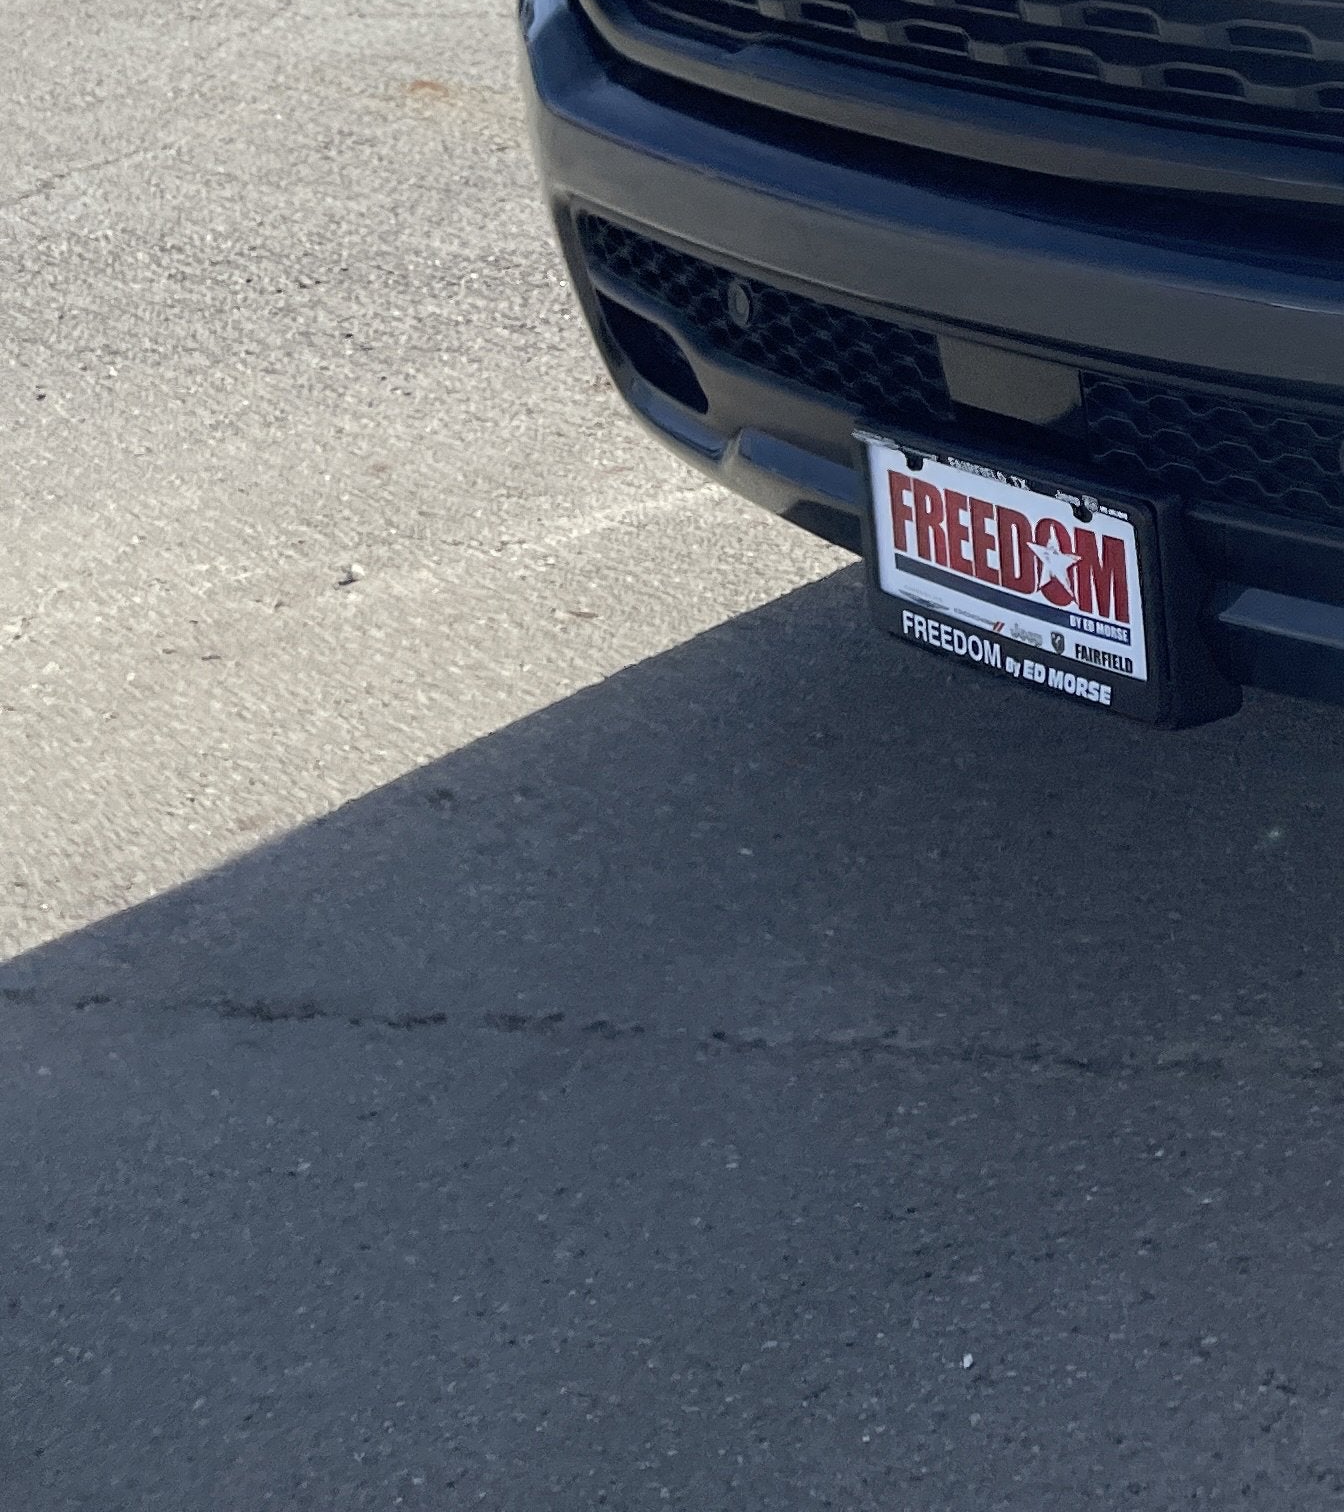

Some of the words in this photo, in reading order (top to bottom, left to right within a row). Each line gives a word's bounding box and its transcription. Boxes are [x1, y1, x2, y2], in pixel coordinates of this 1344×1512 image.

[888, 470, 1131, 624] FREEDOM
[902, 609, 1002, 669] FREEDOM
[1022, 659, 1046, 684] ED
[1047, 667, 1112, 706] MORSE
[1069, 614, 1082, 629] BY
[1082, 618, 1095, 633] ED
[1095, 621, 1129, 643] MORSE
[1075, 643, 1133, 674] FAIRFIELD
